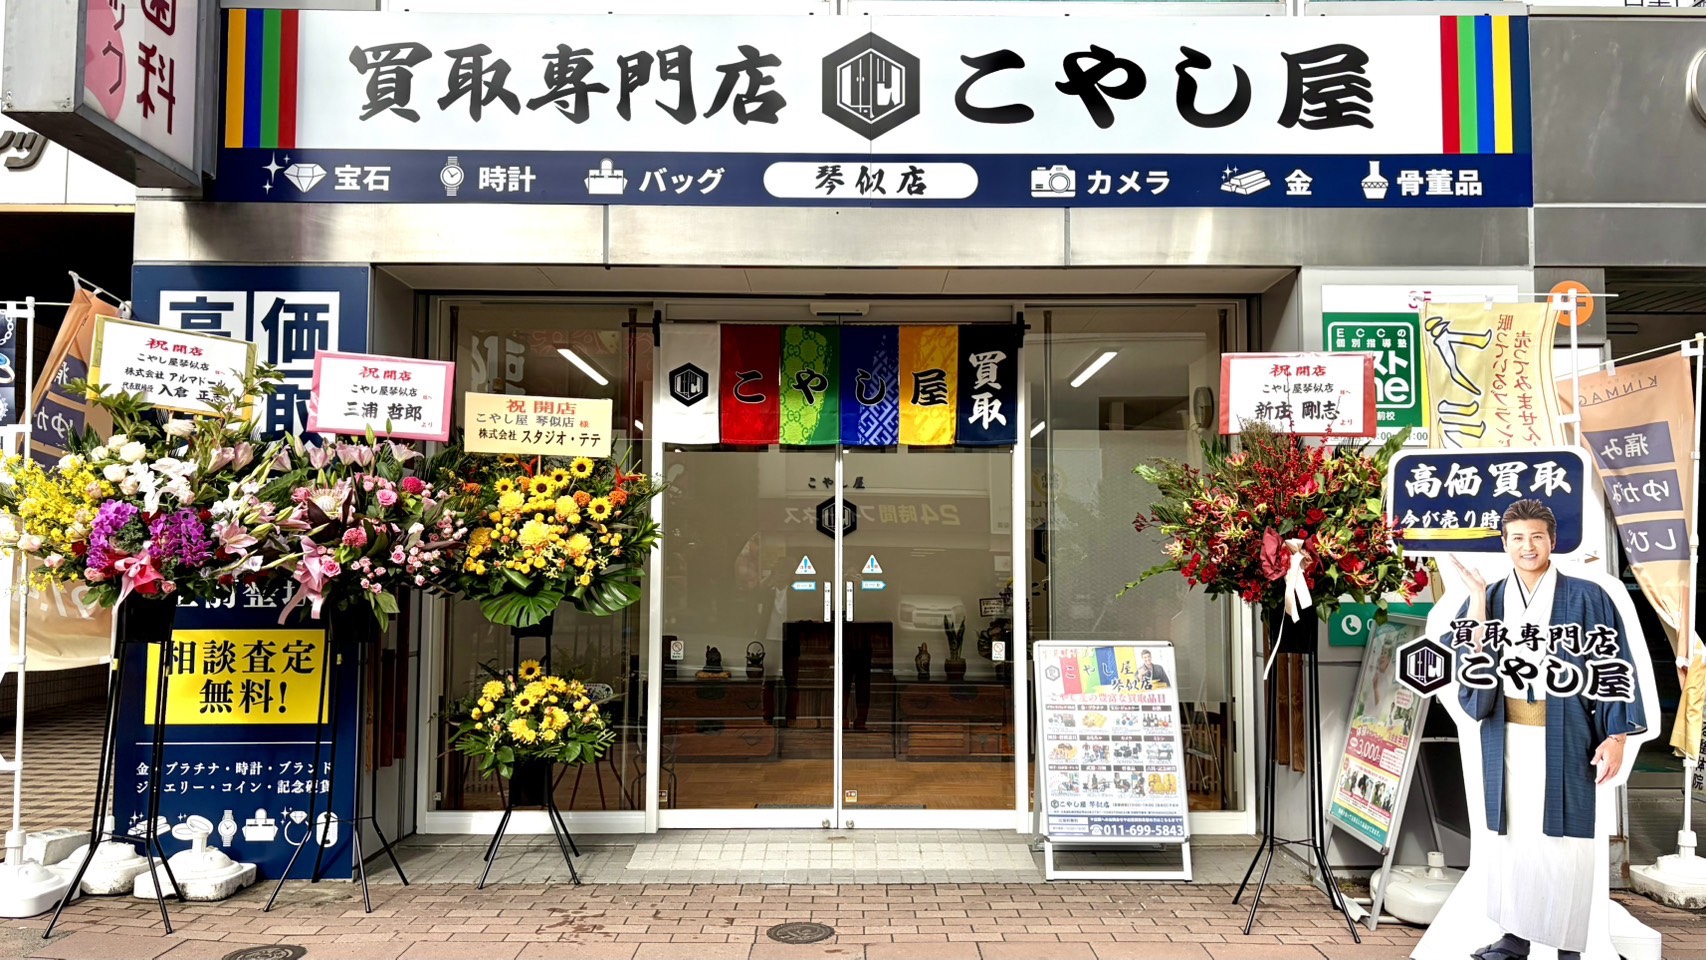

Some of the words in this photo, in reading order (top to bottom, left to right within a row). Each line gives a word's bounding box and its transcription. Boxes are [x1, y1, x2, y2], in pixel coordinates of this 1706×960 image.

[348, 41, 787, 125] 買取専門店
[954, 43, 1374, 129] こやし屋
[334, 163, 391, 192] 宝石
[478, 165, 536, 193] 時計
[639, 167, 725, 195] バッグ
[815, 164, 928, 196] 琴似店
[1087, 169, 1170, 195] カメラ
[1284, 169, 1313, 195] 金
[1396, 169, 1483, 197] 骨董品
[1336, 327, 1407, 338] ECCの
[124, 366, 165, 380] 株式会社
[733, 367, 948, 406] こやし屋
[351, 384, 418, 397] こやし屋琴似店
[968, 350, 1007, 431] 買取
[1262, 383, 1334, 394] こやし屋琴似店
[478, 427, 517, 441] 株式会社
[521, 429, 601, 447] スタジオ・テテ
[1405, 461, 1572, 498] 高価買取
[1401, 509, 1500, 530] 今が売り時
[1450, 619, 1619, 657] 買取専門店
[169, 639, 316, 675] 相談査定
[1460, 656, 1633, 699] こやし屋
[199, 678, 288, 714] 無料!
[1103, 824, 1184, 836] 011-699-5843
